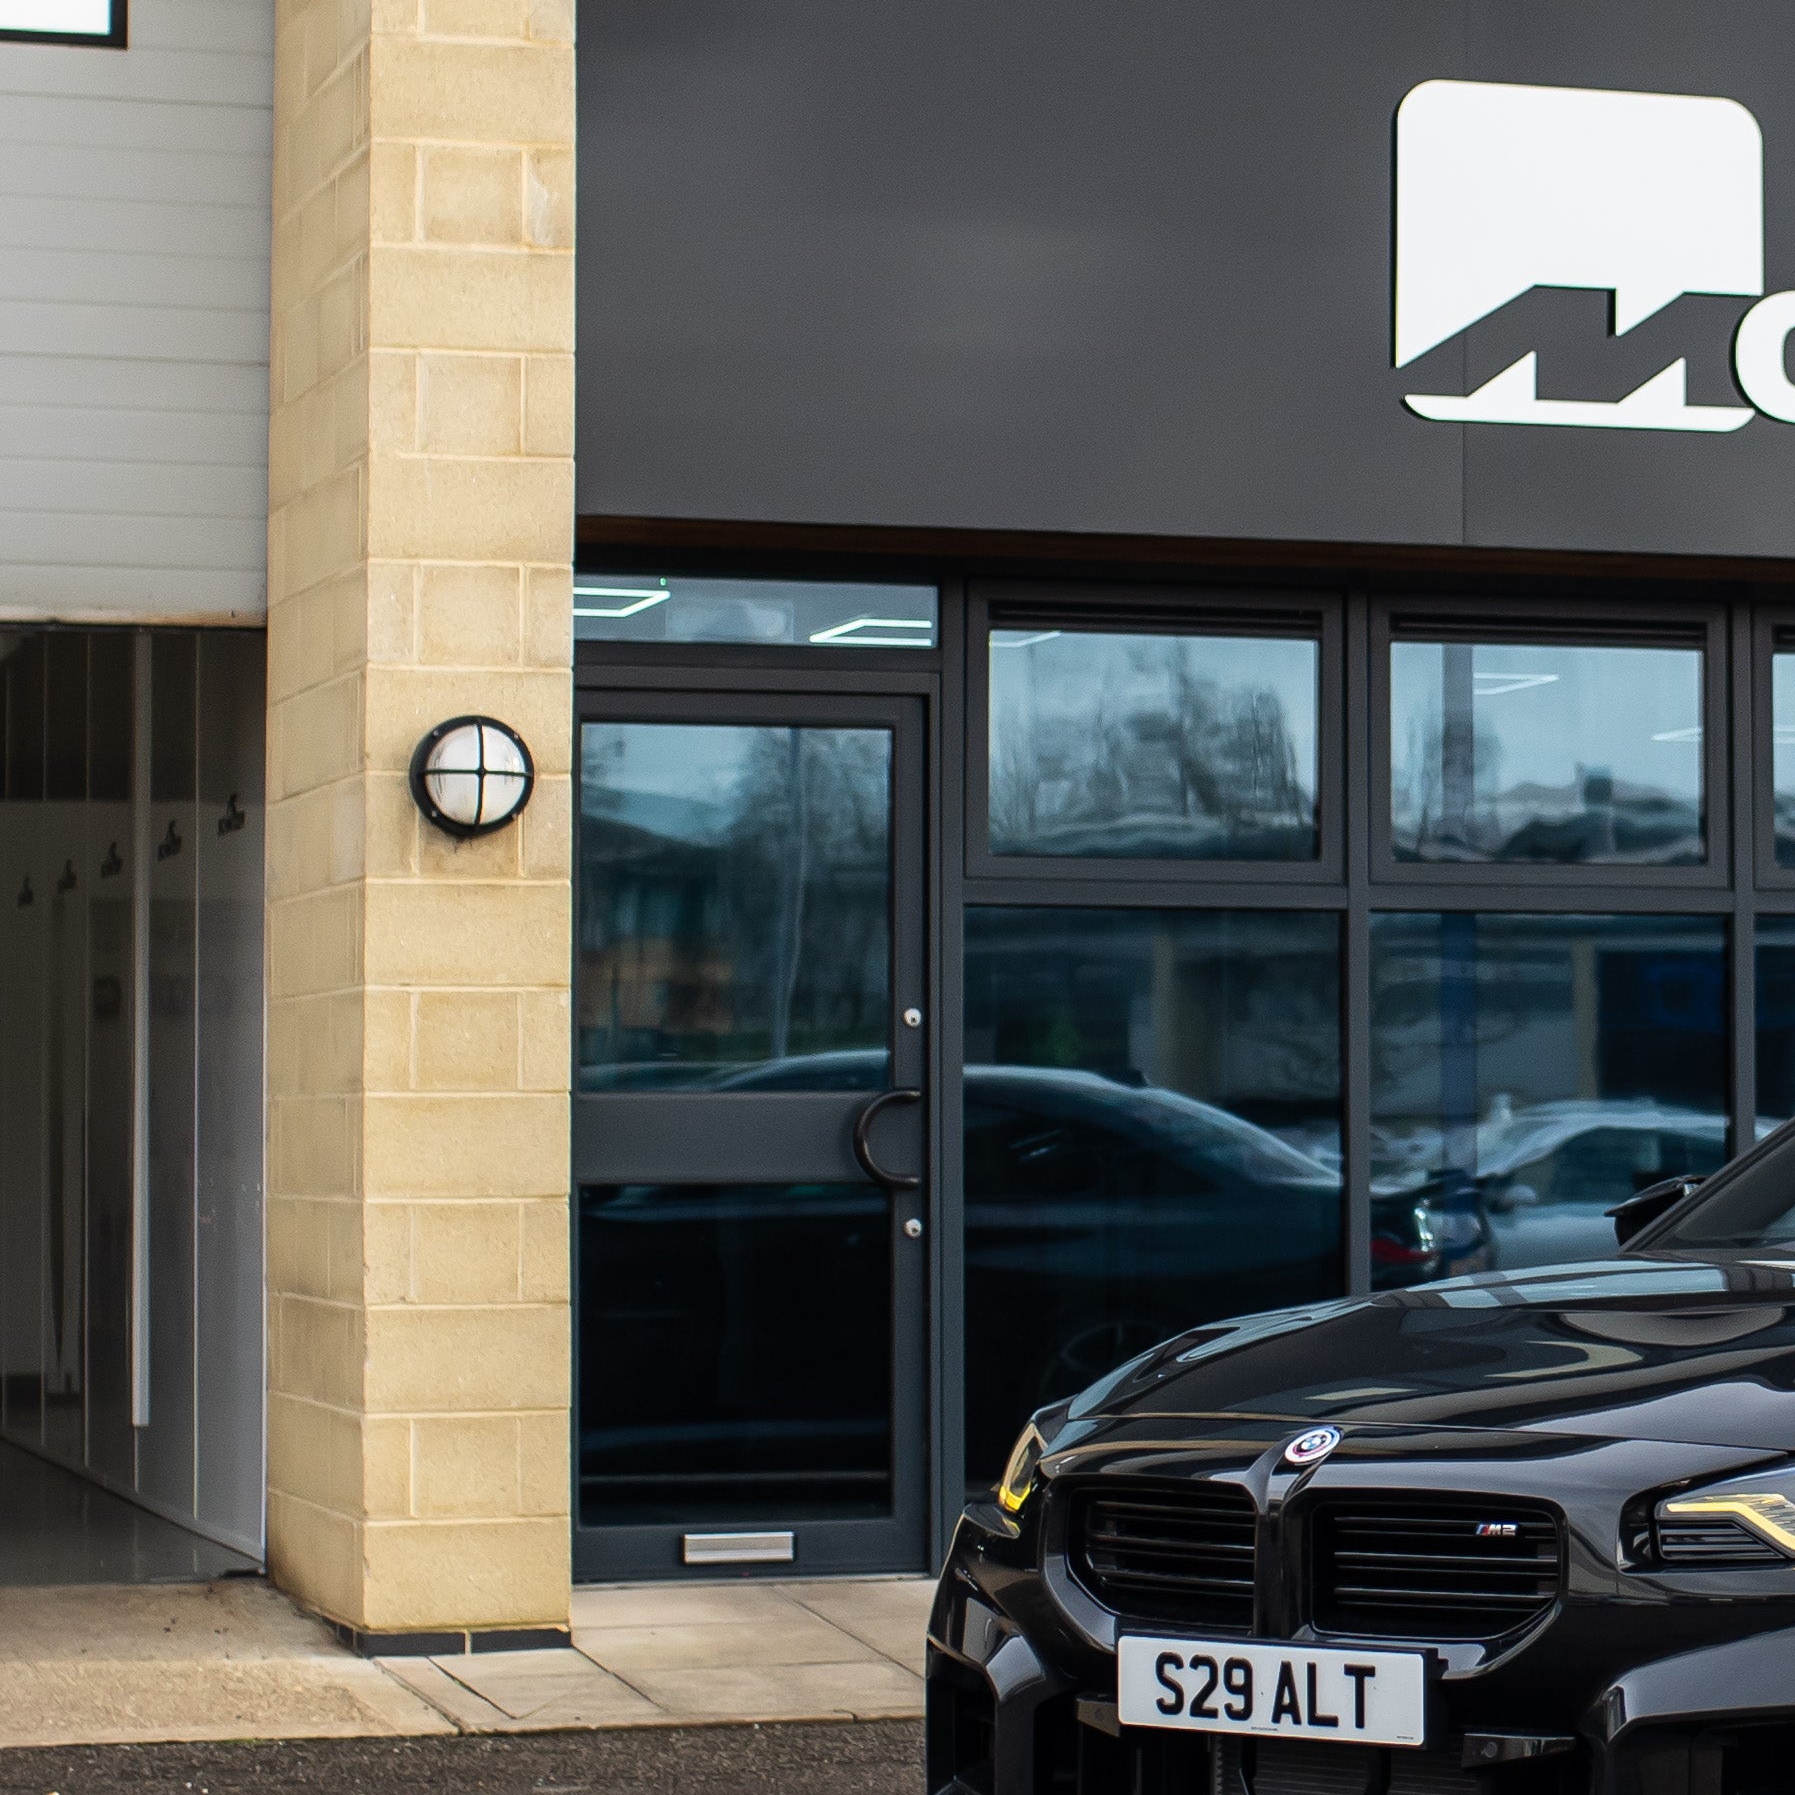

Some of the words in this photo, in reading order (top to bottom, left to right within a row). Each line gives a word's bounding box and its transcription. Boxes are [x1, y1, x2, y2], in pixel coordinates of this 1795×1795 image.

[1485, 1523, 1518, 1537] M2
[1155, 1651, 1255, 1723] S29
[1270, 1660, 1377, 1730] ALT
